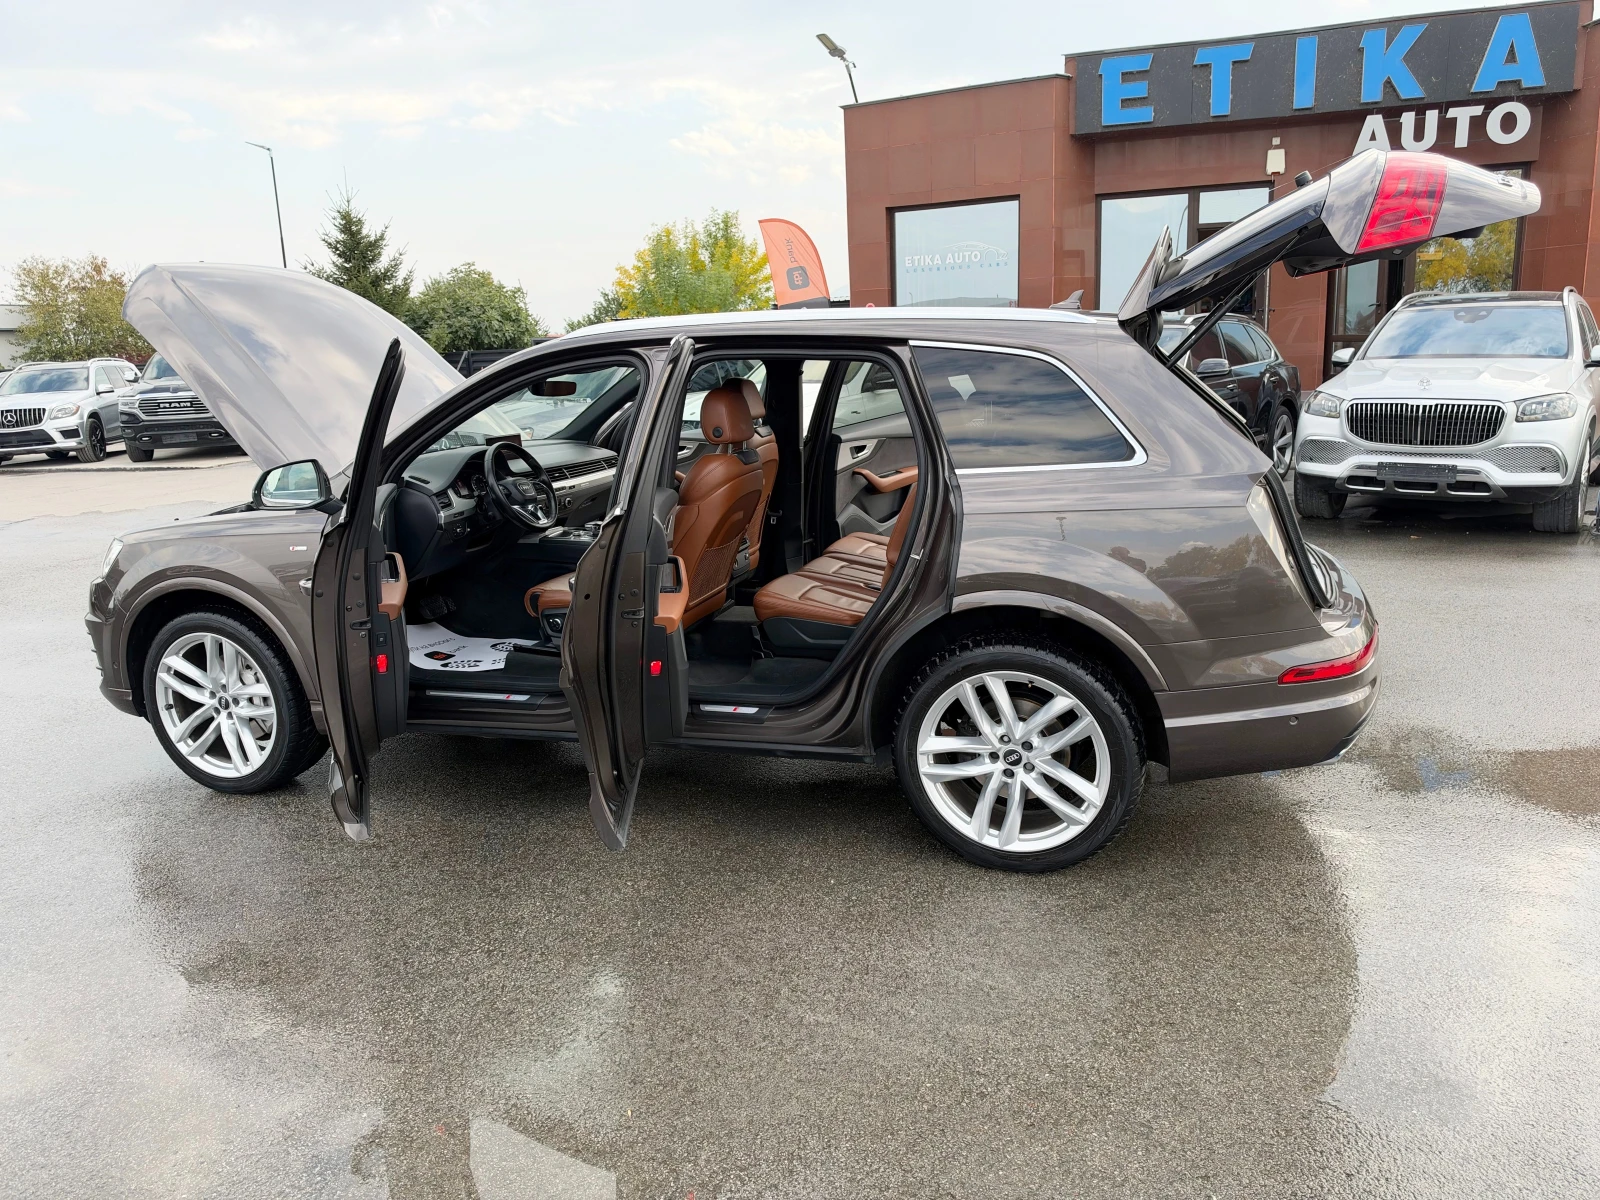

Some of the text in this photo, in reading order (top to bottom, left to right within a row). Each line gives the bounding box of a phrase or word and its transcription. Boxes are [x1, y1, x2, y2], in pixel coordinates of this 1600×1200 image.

[1099, 12, 1547, 127] ETIKA
[1353, 101, 1533, 155] AUTO
[905, 251, 981, 267] ETIKA AUTO
